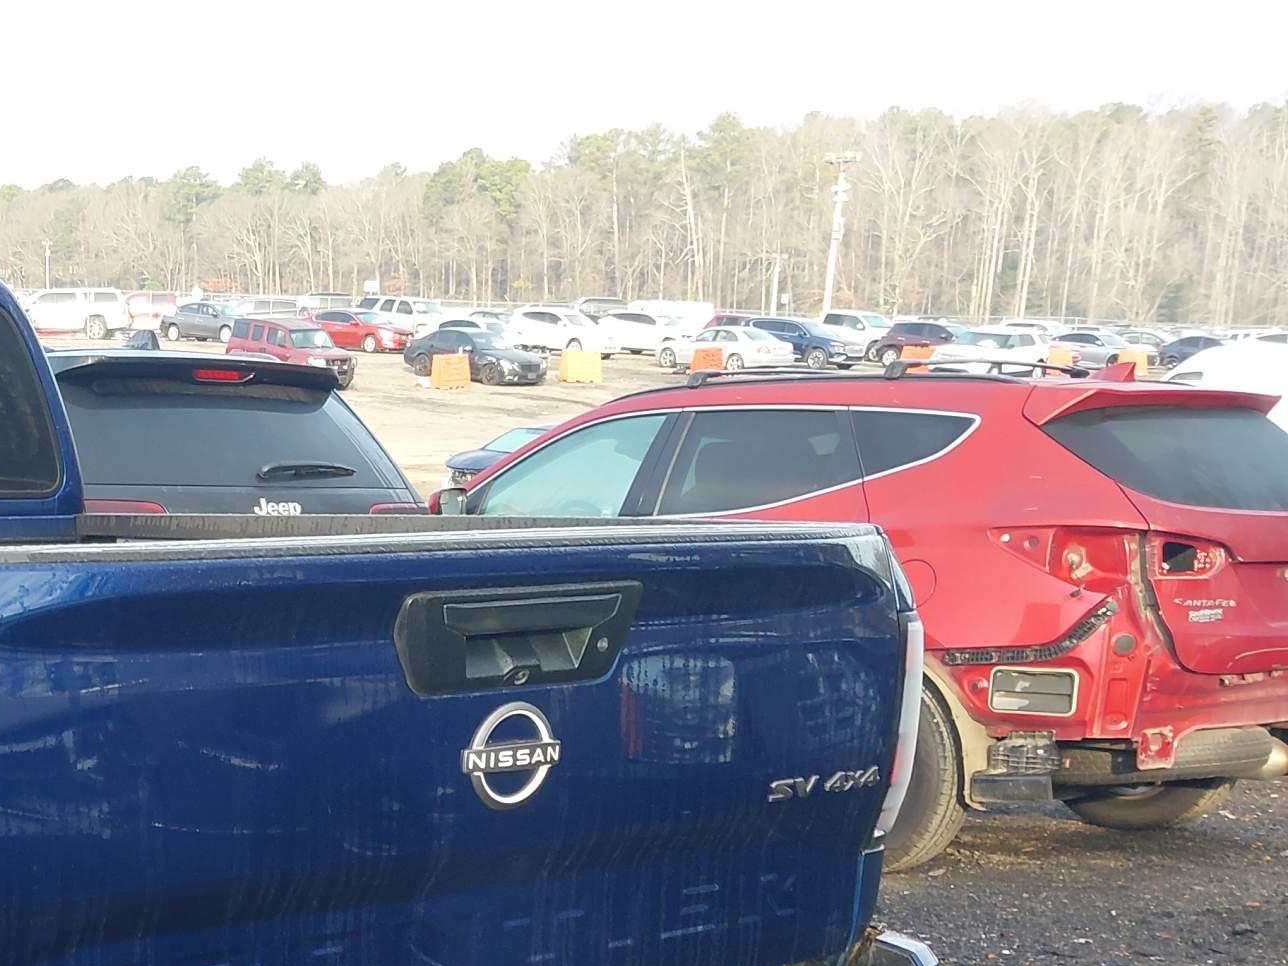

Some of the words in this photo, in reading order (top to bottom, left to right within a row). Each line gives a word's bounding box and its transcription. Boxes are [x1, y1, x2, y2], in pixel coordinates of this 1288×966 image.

[253, 497, 302, 516] Jeep
[468, 745, 560, 770] NISSAN
[768, 775, 820, 802] SV
